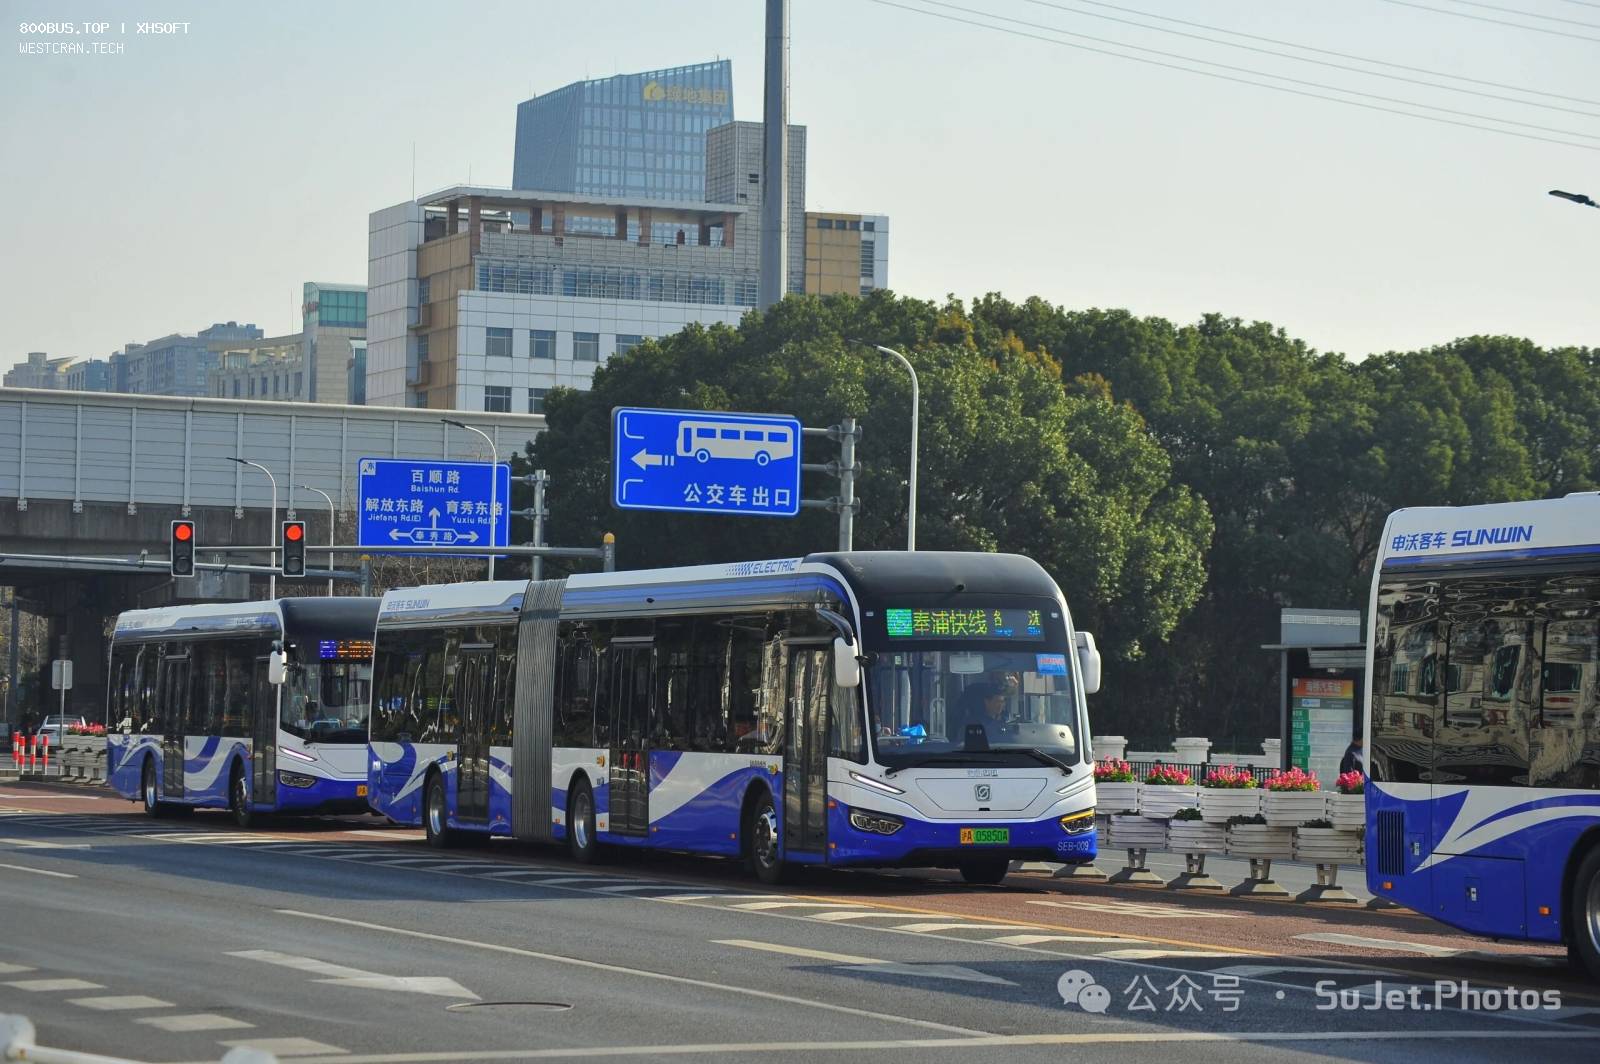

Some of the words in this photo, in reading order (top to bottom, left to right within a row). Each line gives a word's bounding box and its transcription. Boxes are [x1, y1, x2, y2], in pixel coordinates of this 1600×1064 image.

[411, 469, 460, 484] 百顺路
[411, 484, 445, 493] Baishun
[683, 482, 791, 507] 公交车出口
[365, 497, 424, 513] 解放东路
[368, 513, 398, 523] Jiefang
[451, 515, 475, 524] Yuxiu
[1391, 532, 1447, 551] 申沃客车
[1450, 525, 1534, 547] SUNWIN
[752, 559, 798, 574] ELECTRIC
[913, 609, 988, 636] 奉浦快线
[1057, 840, 1090, 852] SEB-009
